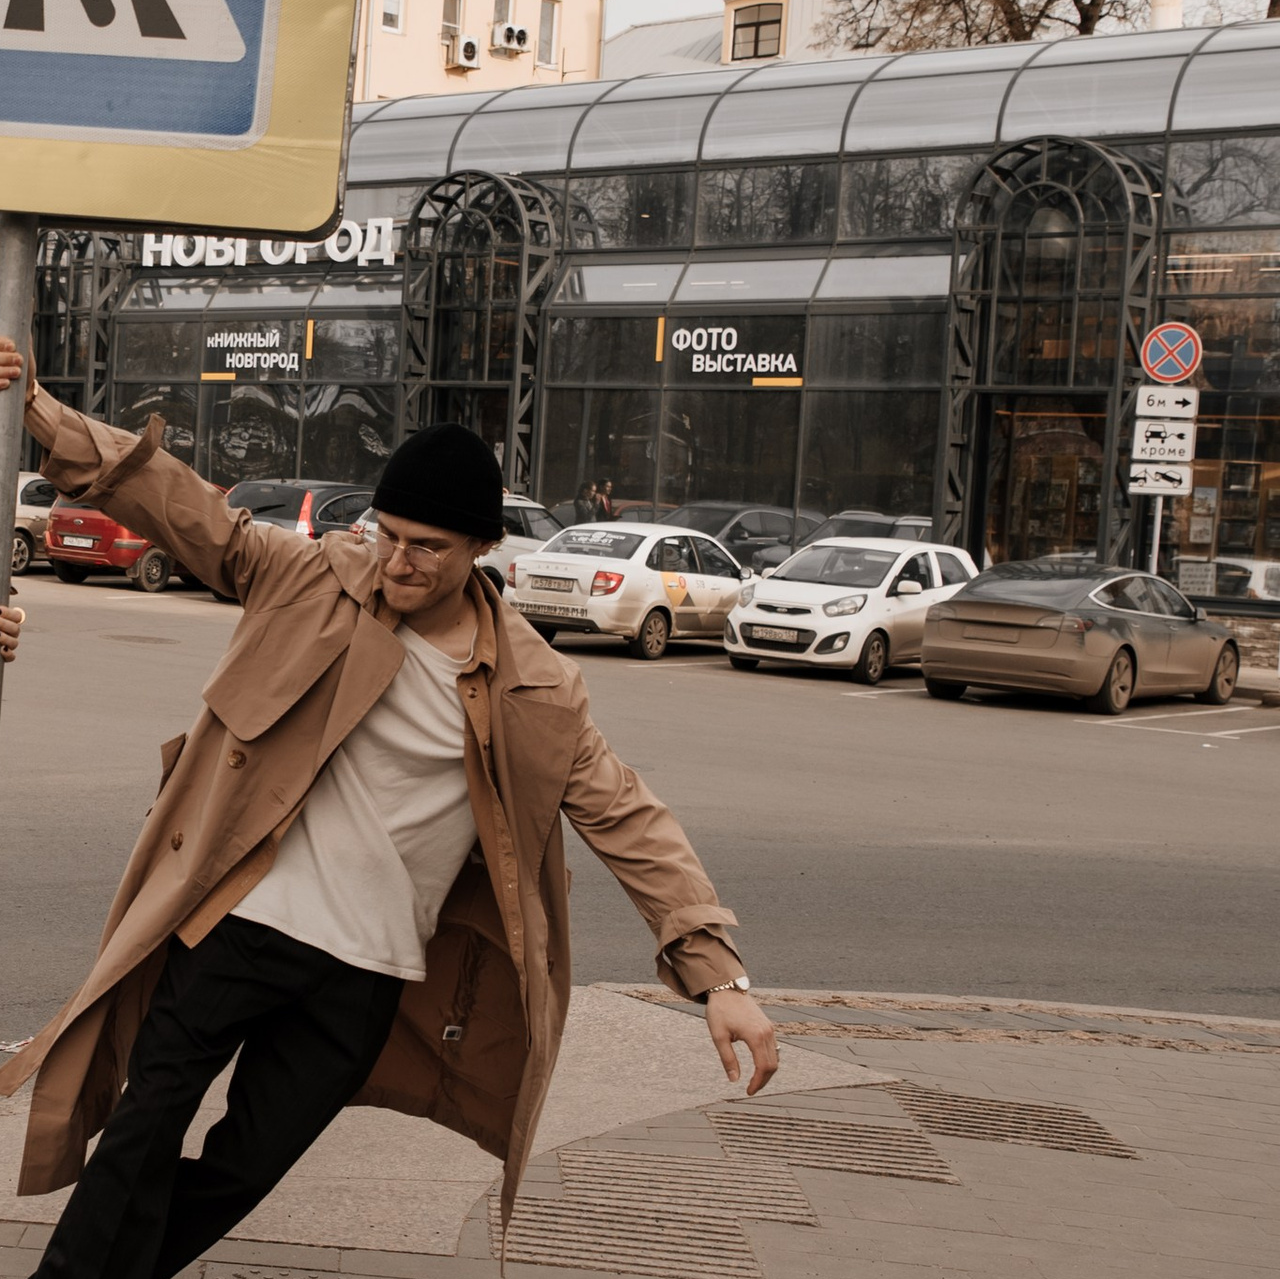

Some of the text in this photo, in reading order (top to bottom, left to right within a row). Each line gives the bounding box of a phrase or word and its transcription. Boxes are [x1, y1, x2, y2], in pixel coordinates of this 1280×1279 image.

[672, 327, 738, 351] ФОТО
[225, 353, 299, 371] НОВГОРОД
[692, 353, 798, 372] ВЫСТАВКА
[1140, 447, 1186, 457] кроме
